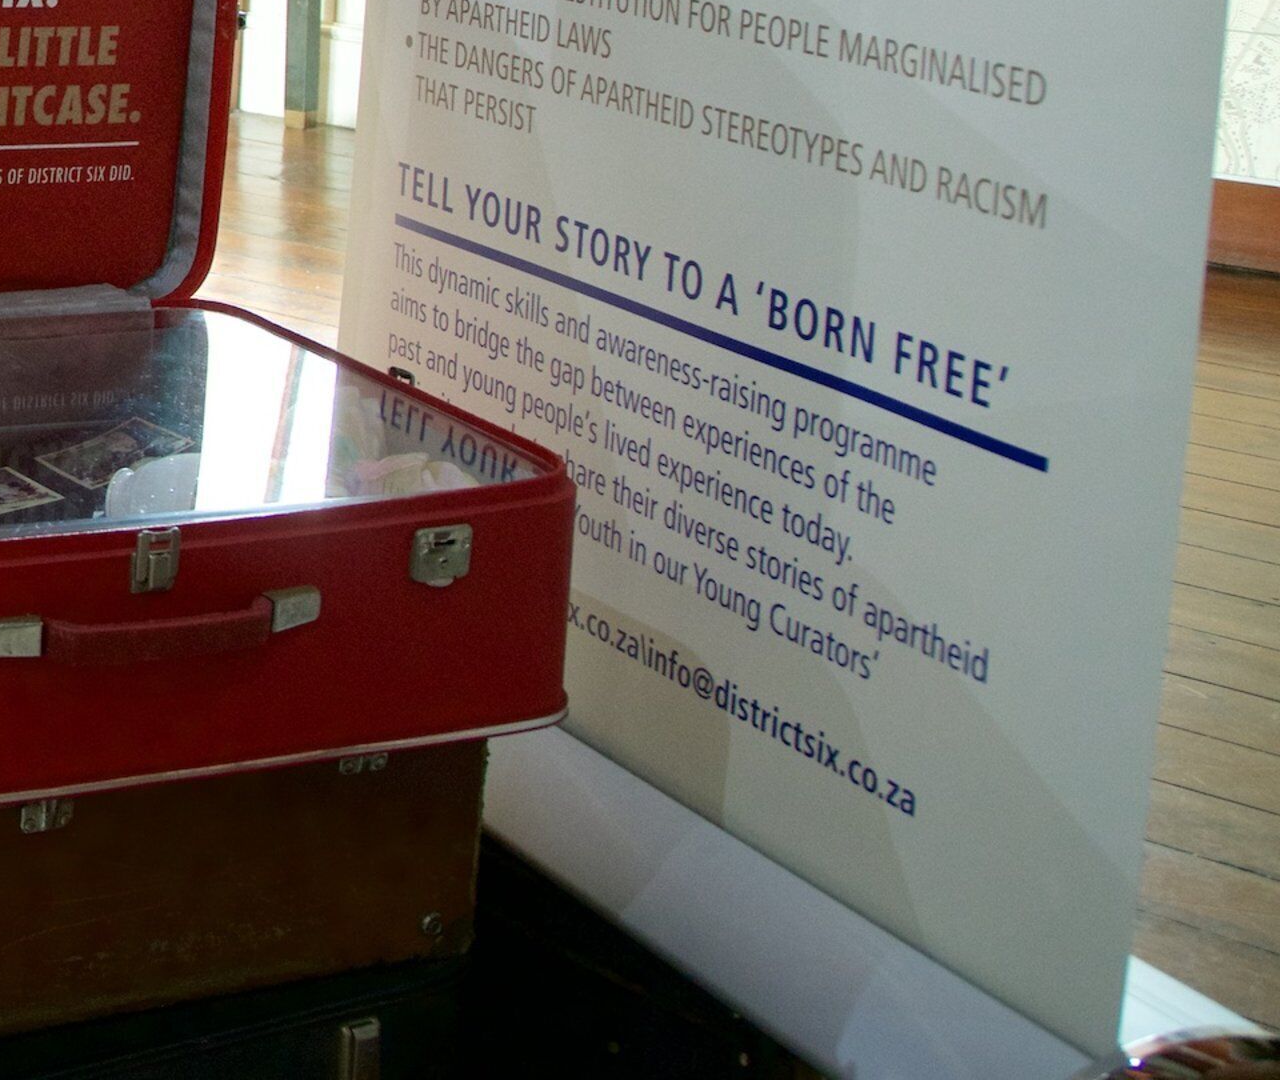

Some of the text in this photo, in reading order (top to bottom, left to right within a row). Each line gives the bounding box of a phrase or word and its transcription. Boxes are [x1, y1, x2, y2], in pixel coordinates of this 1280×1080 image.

[6, 167, 25, 186] OF
[27, 165, 84, 185] DISTRICT
[85, 165, 107, 184] SIX
[108, 163, 135, 183] DID.
[399, 161, 453, 213] TELL
[465, 183, 542, 245] YOUR
[555, 214, 651, 282] STORY
[665, 250, 704, 301] TO
[716, 272, 739, 317] A
